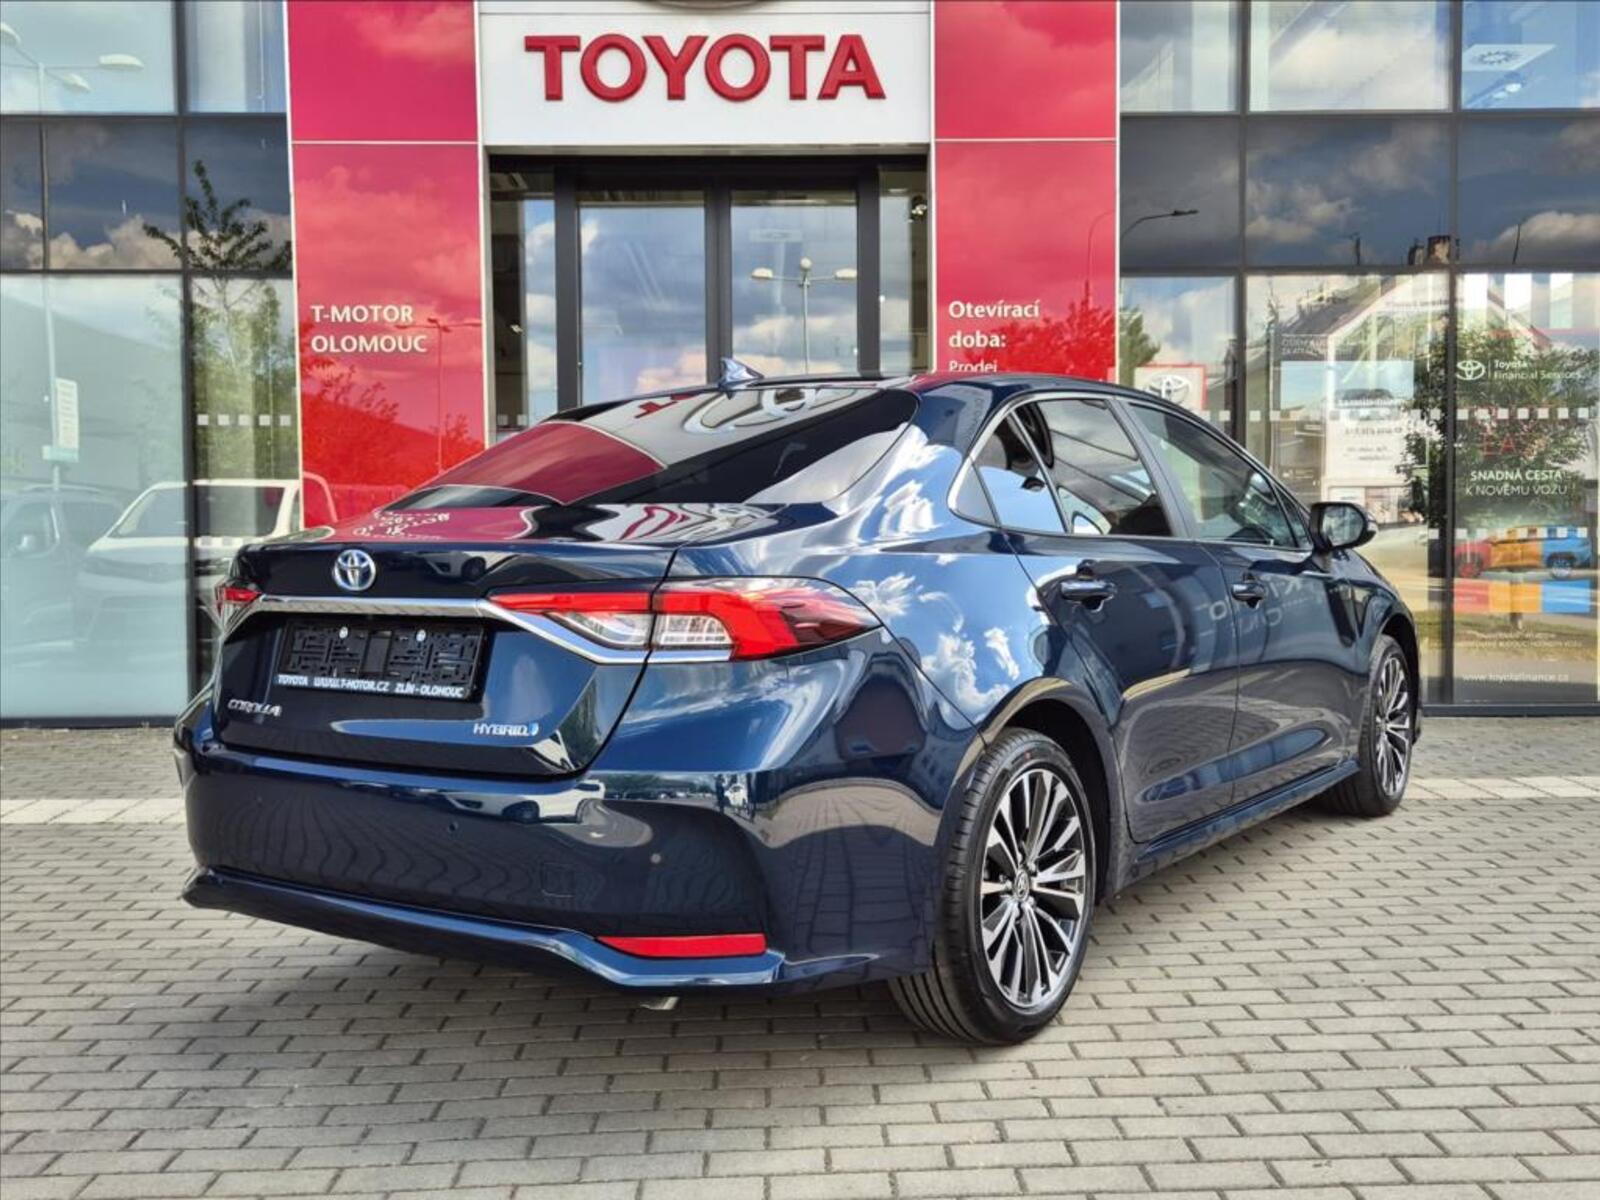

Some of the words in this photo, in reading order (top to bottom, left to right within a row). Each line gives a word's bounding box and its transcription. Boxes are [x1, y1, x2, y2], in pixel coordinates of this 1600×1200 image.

[524, 34, 887, 102] TOYOTA
[310, 305, 414, 323] T-MOTOR
[948, 299, 1041, 318] Otevírací
[311, 335, 428, 353] OLOMOUC
[949, 330, 1007, 348] doba:
[1493, 360, 1528, 370] Toyota
[1493, 371, 1538, 380] Financial
[1525, 470, 1562, 481] CESTA
[1465, 485, 1473, 496] K
[1533, 485, 1568, 495] VOZU
[278, 674, 308, 687] TOYOTA
[473, 723, 529, 737] HYBRID
